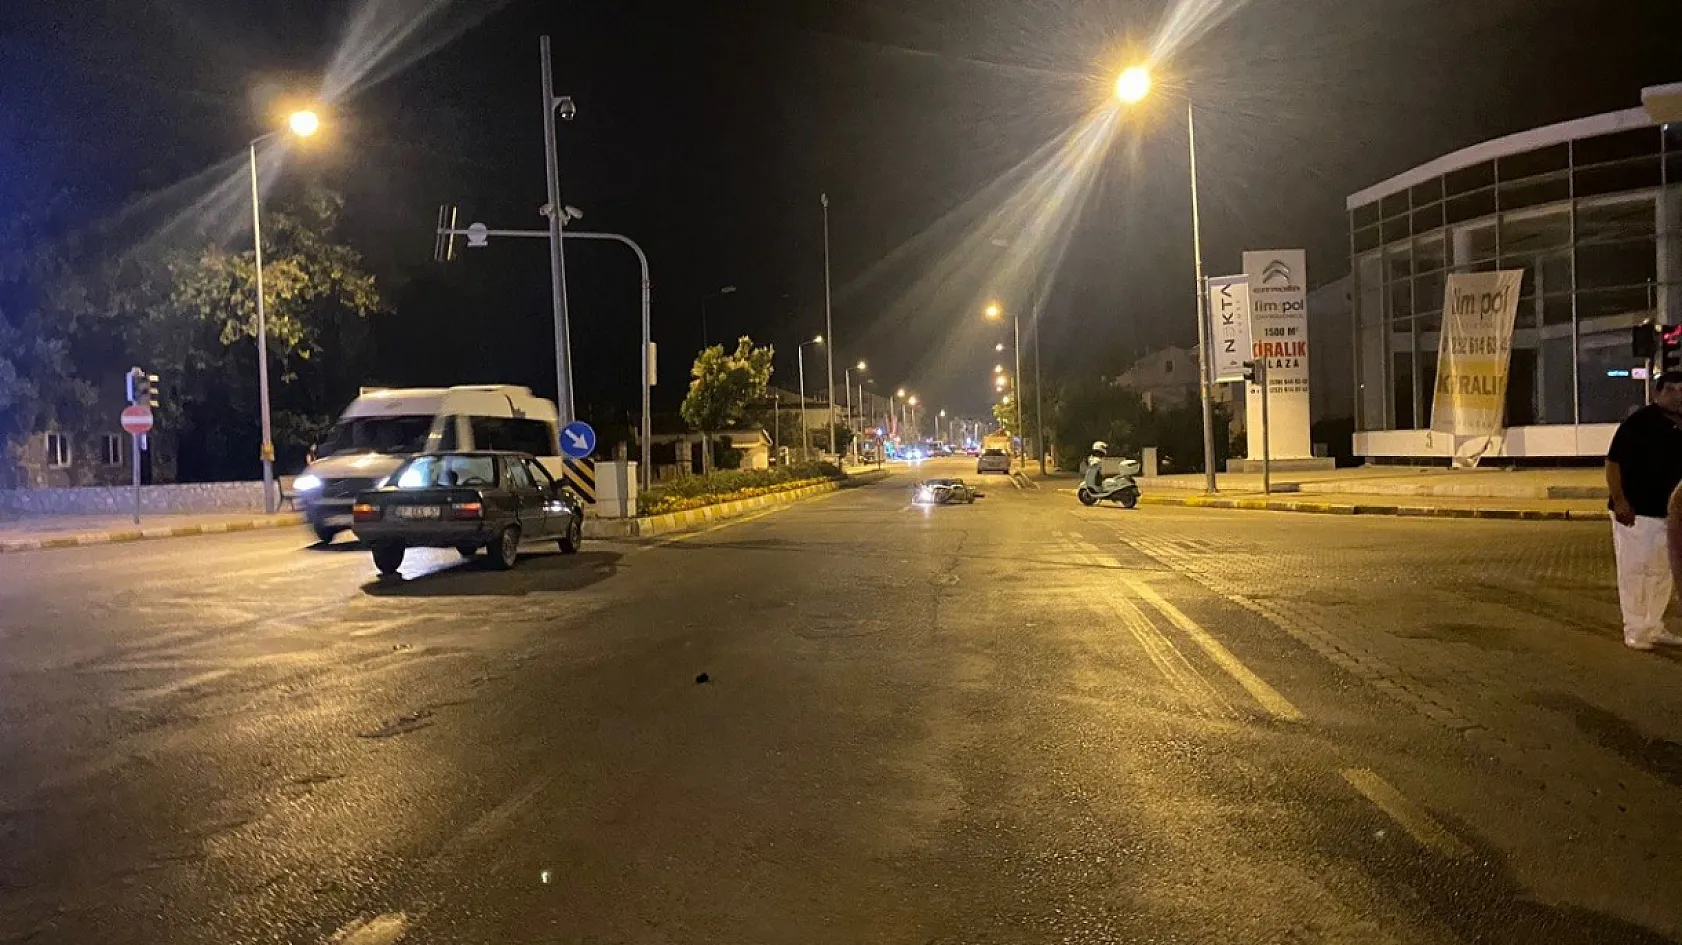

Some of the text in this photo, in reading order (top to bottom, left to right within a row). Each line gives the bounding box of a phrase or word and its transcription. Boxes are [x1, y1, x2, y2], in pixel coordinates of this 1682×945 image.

[1282, 299, 1304, 314] pol
[1265, 327, 1285, 337] 1500
[1267, 358, 1300, 369] LAZA
[1437, 375, 1504, 395] KRALI
